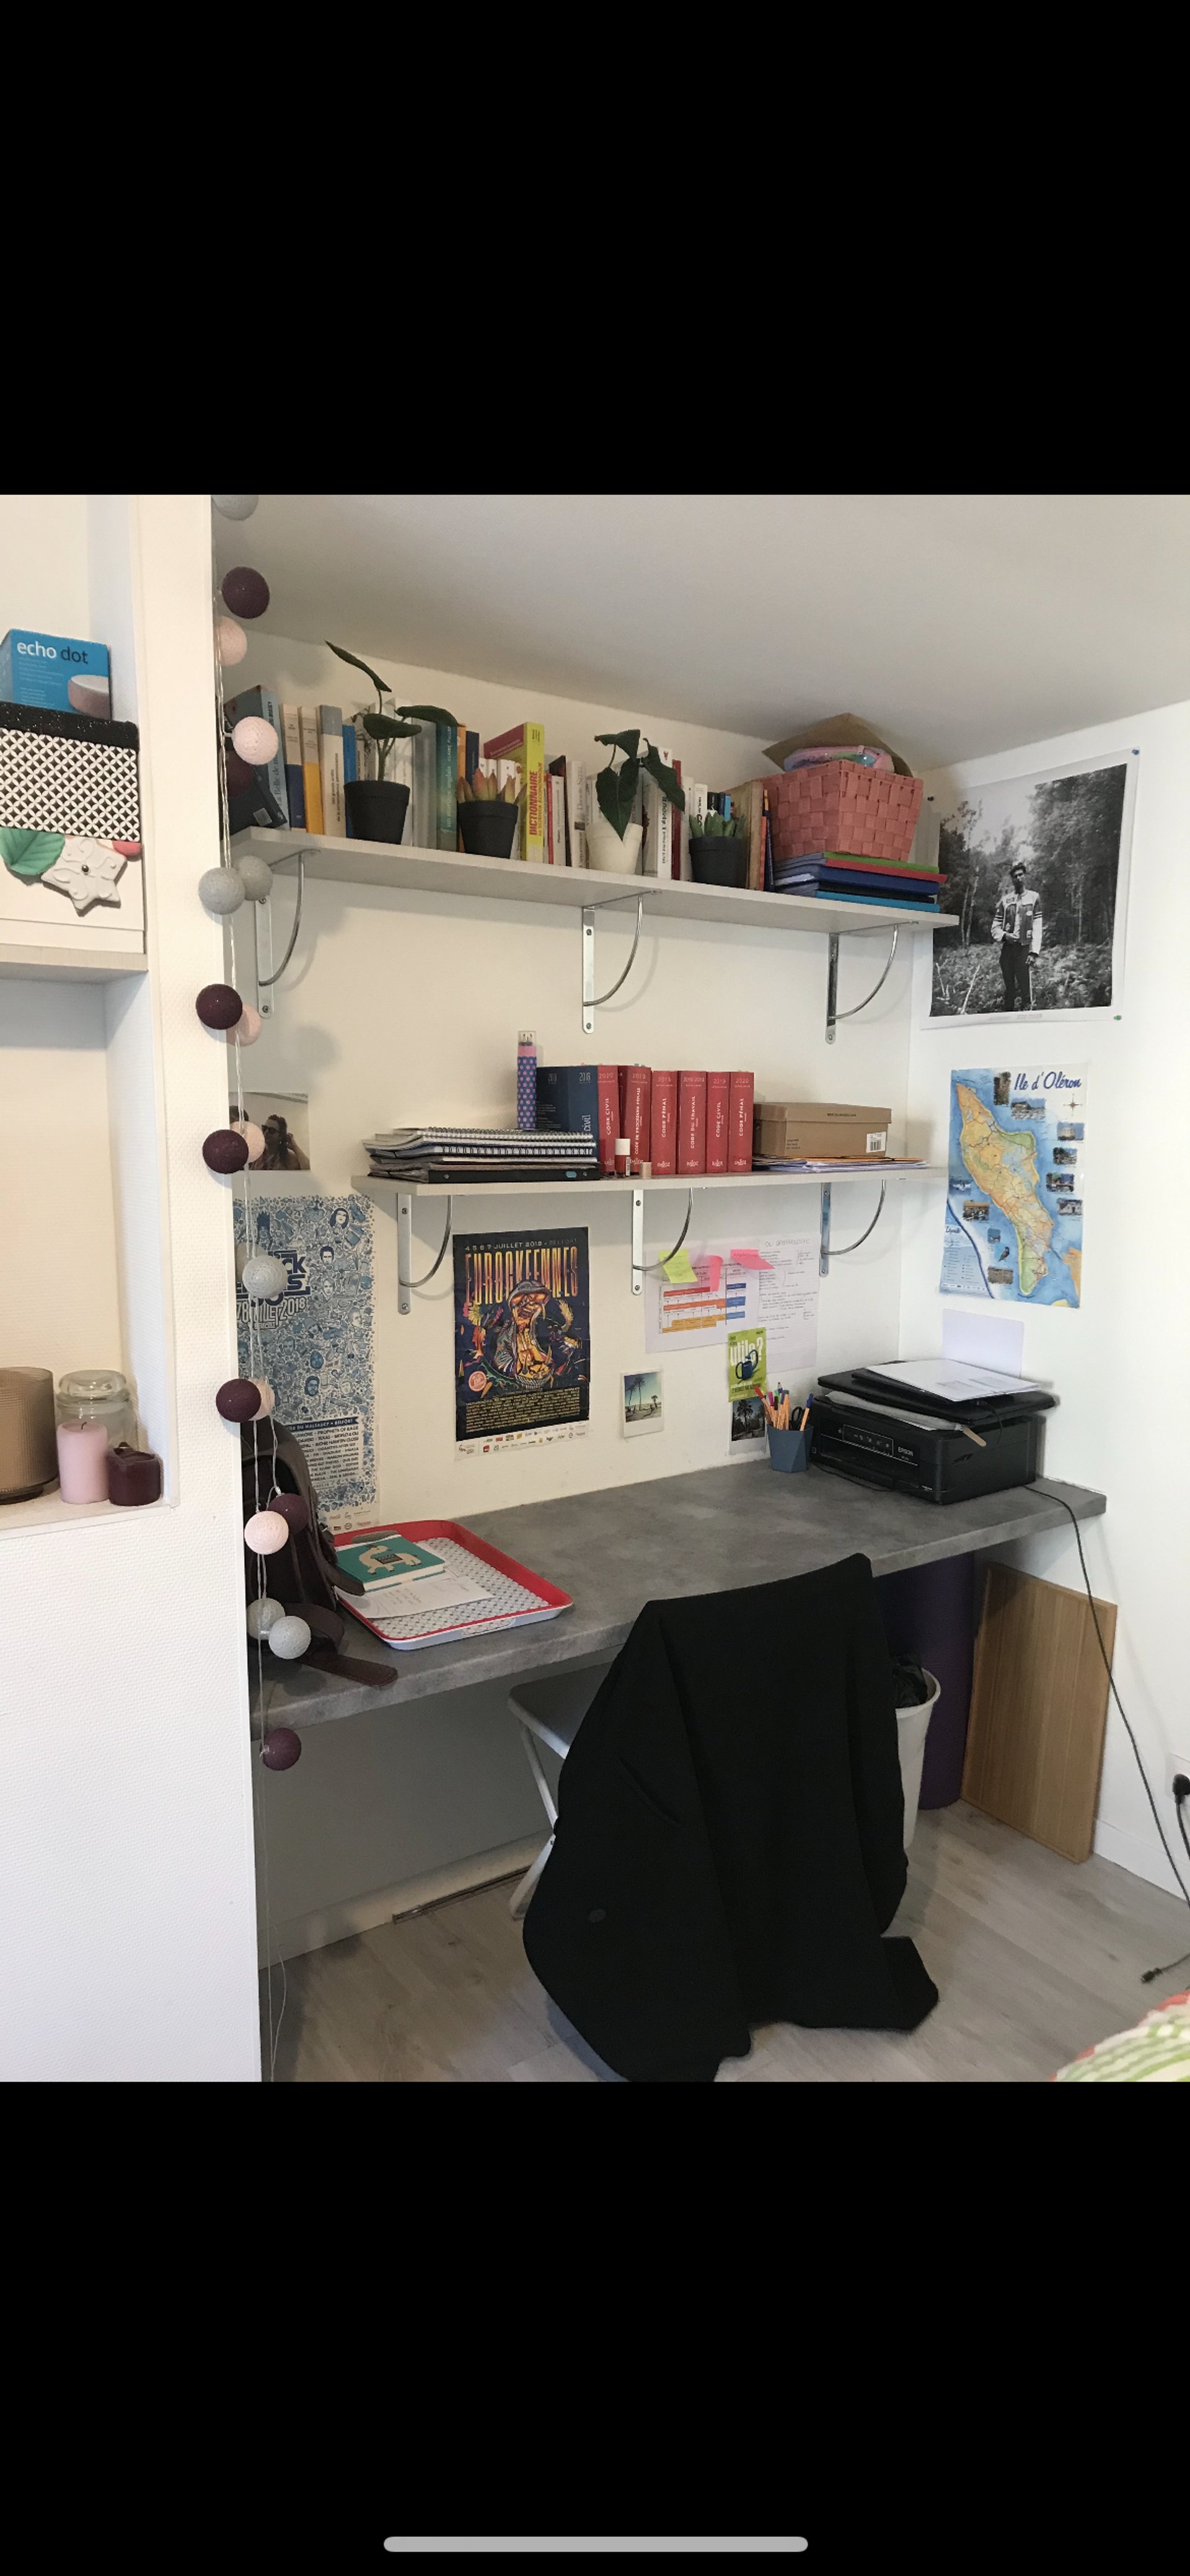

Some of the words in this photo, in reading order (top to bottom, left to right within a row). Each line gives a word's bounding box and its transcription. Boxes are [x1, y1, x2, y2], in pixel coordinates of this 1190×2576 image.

[17, 640, 57, 658] echo
[61, 646, 88, 664] dot
[529, 771, 538, 836] DICTIONNAIRE
[1014, 1073, 1029, 1091] Ile
[1031, 1071, 1082, 1091] d'Oléron
[279, 1297, 307, 1321] 2018
